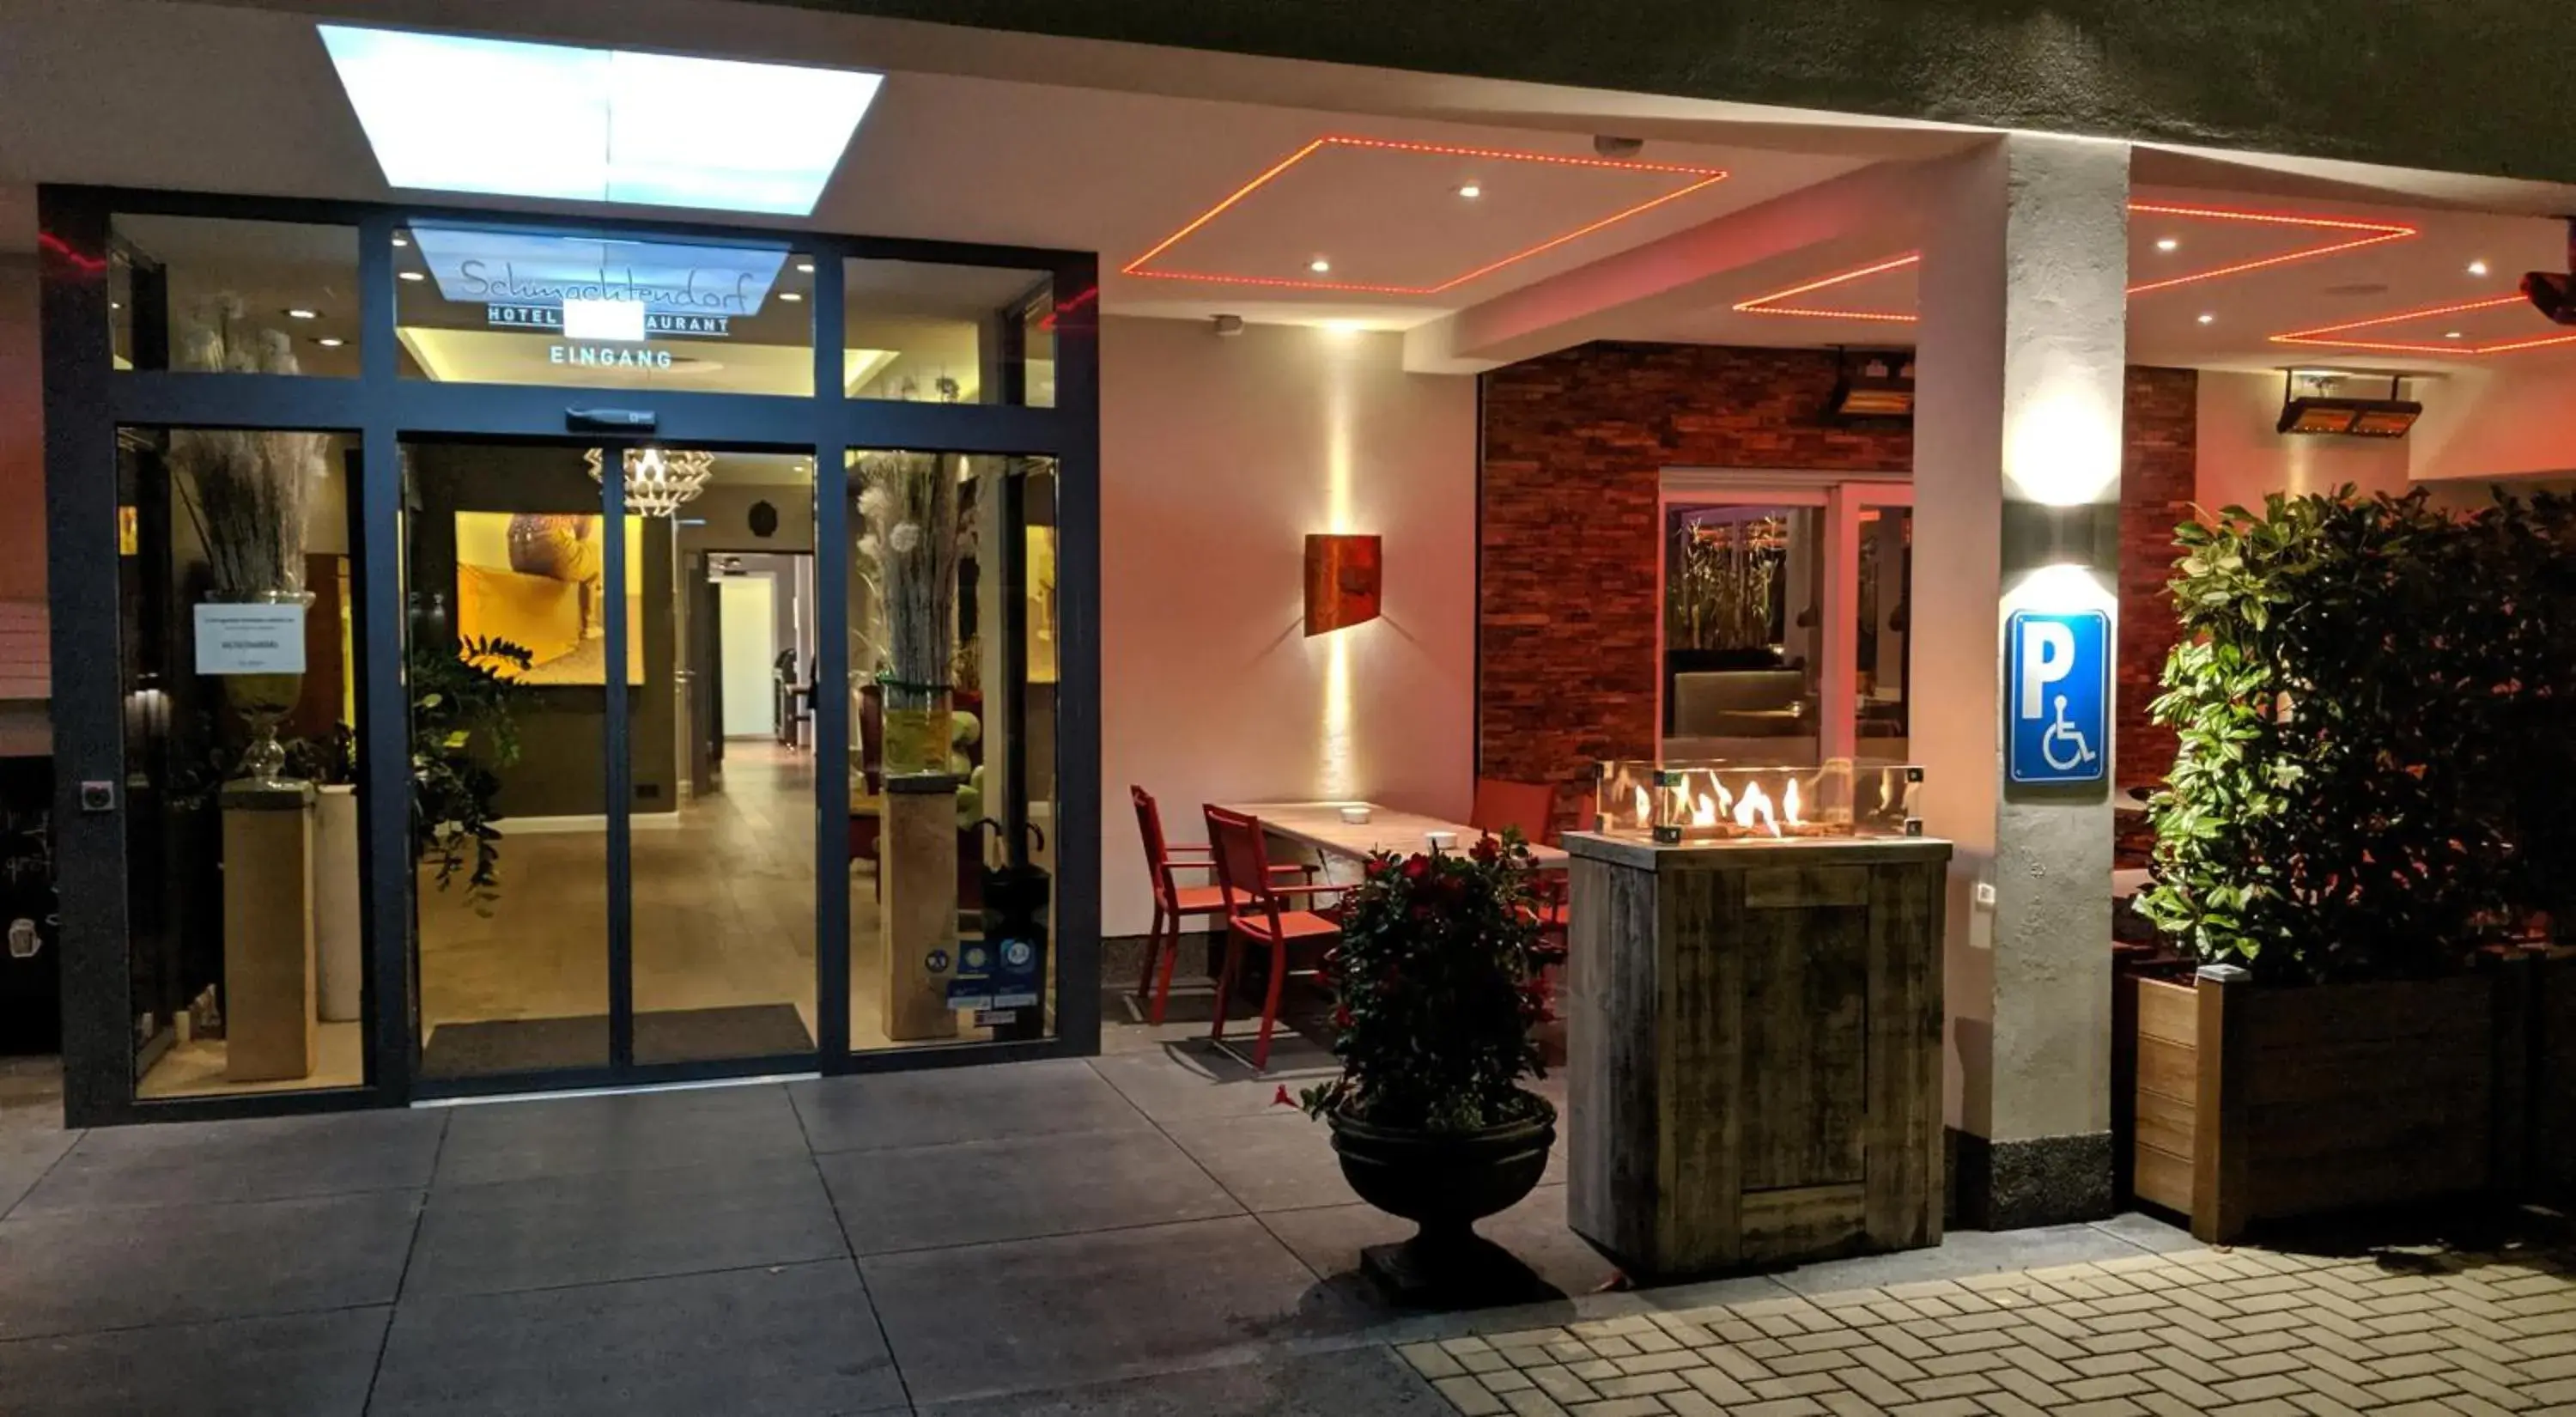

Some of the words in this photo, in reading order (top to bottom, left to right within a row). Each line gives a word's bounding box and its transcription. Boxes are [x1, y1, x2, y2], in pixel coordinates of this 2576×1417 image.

[460, 259, 754, 315] Schmachtendorf
[488, 307, 556, 324] HOTEL
[647, 314, 729, 332] AURANT
[550, 345, 672, 369] EINGANG
[2022, 621, 2075, 719] P
